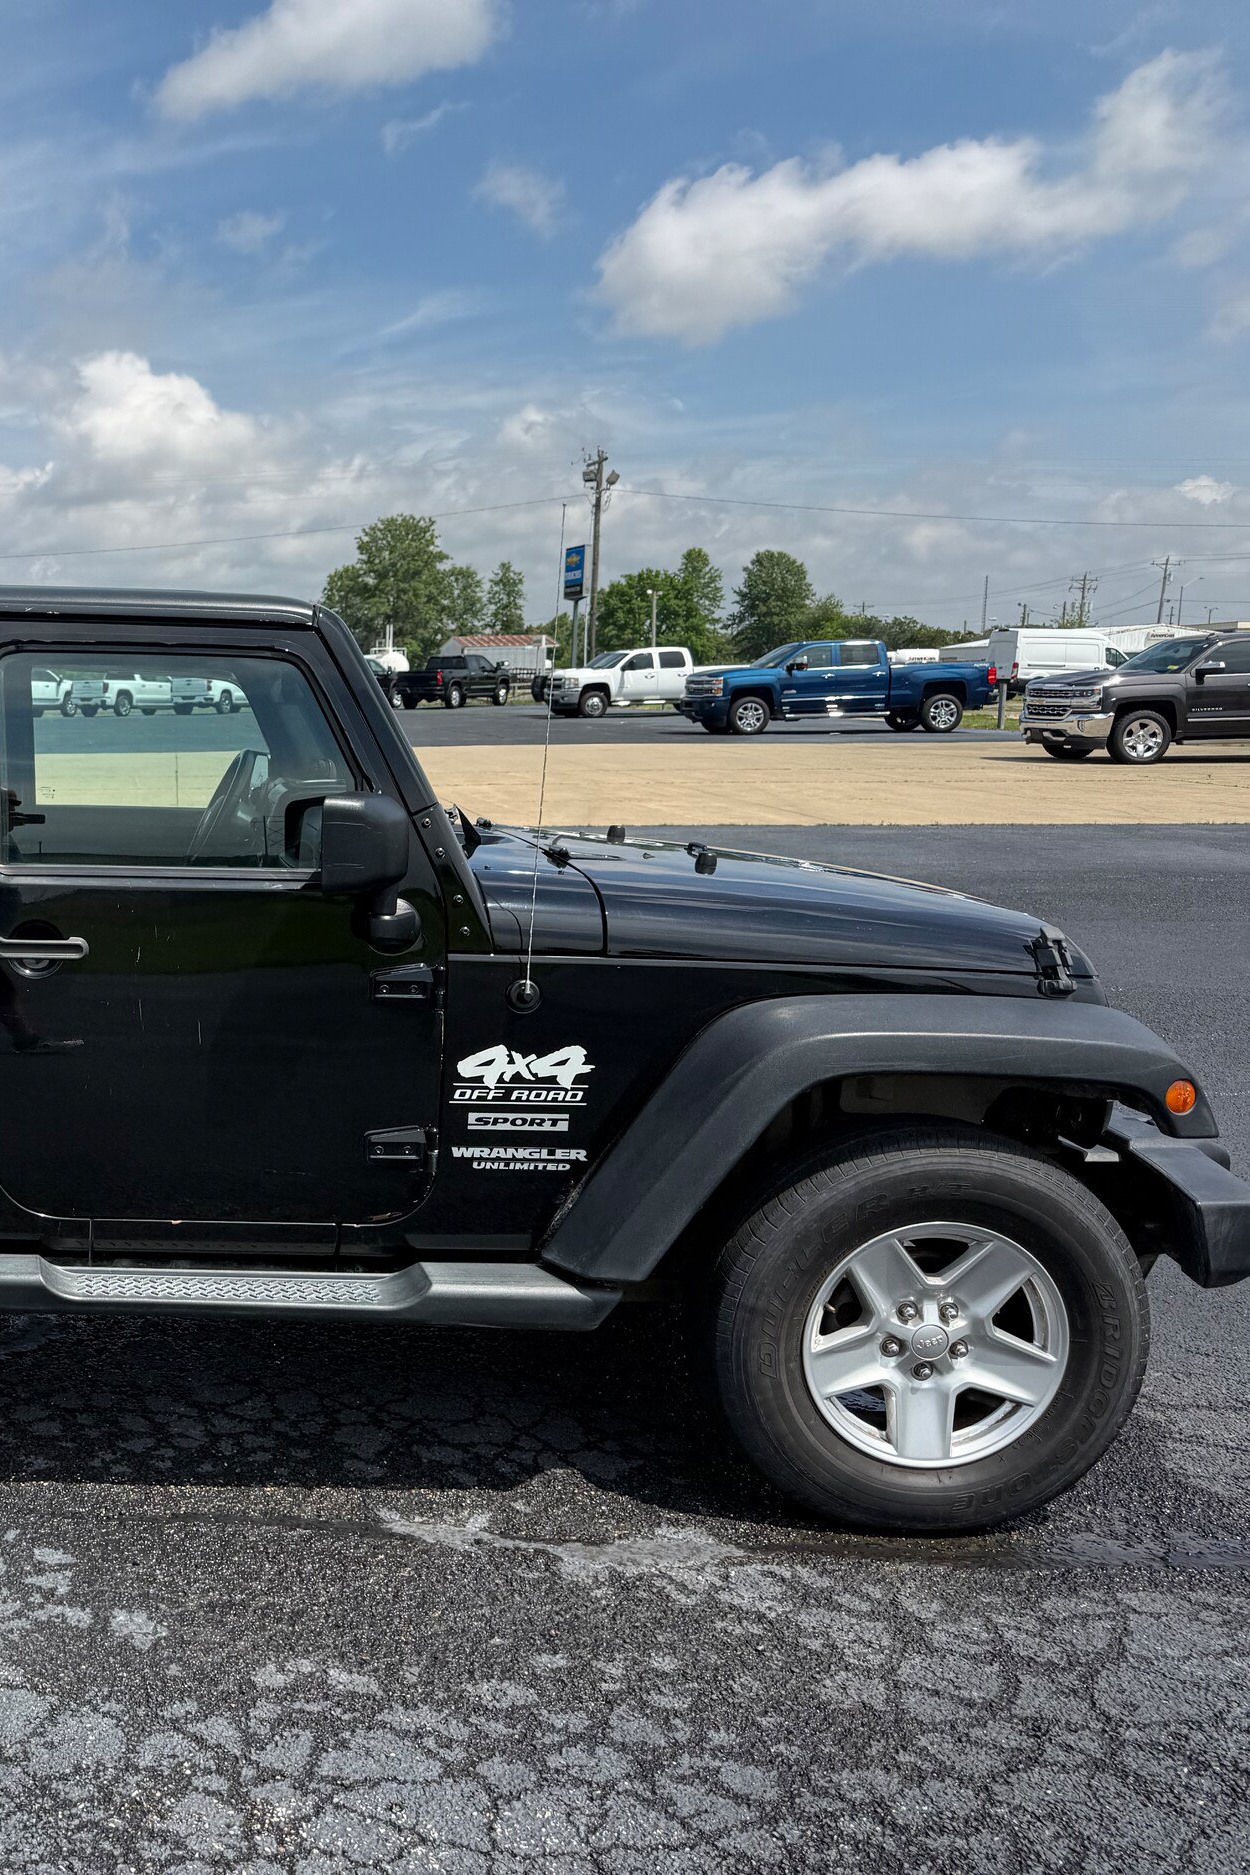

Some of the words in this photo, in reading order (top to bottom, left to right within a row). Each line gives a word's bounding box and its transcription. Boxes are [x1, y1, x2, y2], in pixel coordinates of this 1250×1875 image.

[456, 1044, 596, 1090] 4x4
[453, 1089, 505, 1100] OFF
[510, 1089, 584, 1101] ROAD
[468, 1116, 569, 1128] SPORT
[451, 1147, 588, 1162] WRANGLER
[472, 1161, 571, 1171] UNLIMITED
[916, 1334, 944, 1350] Jeep
